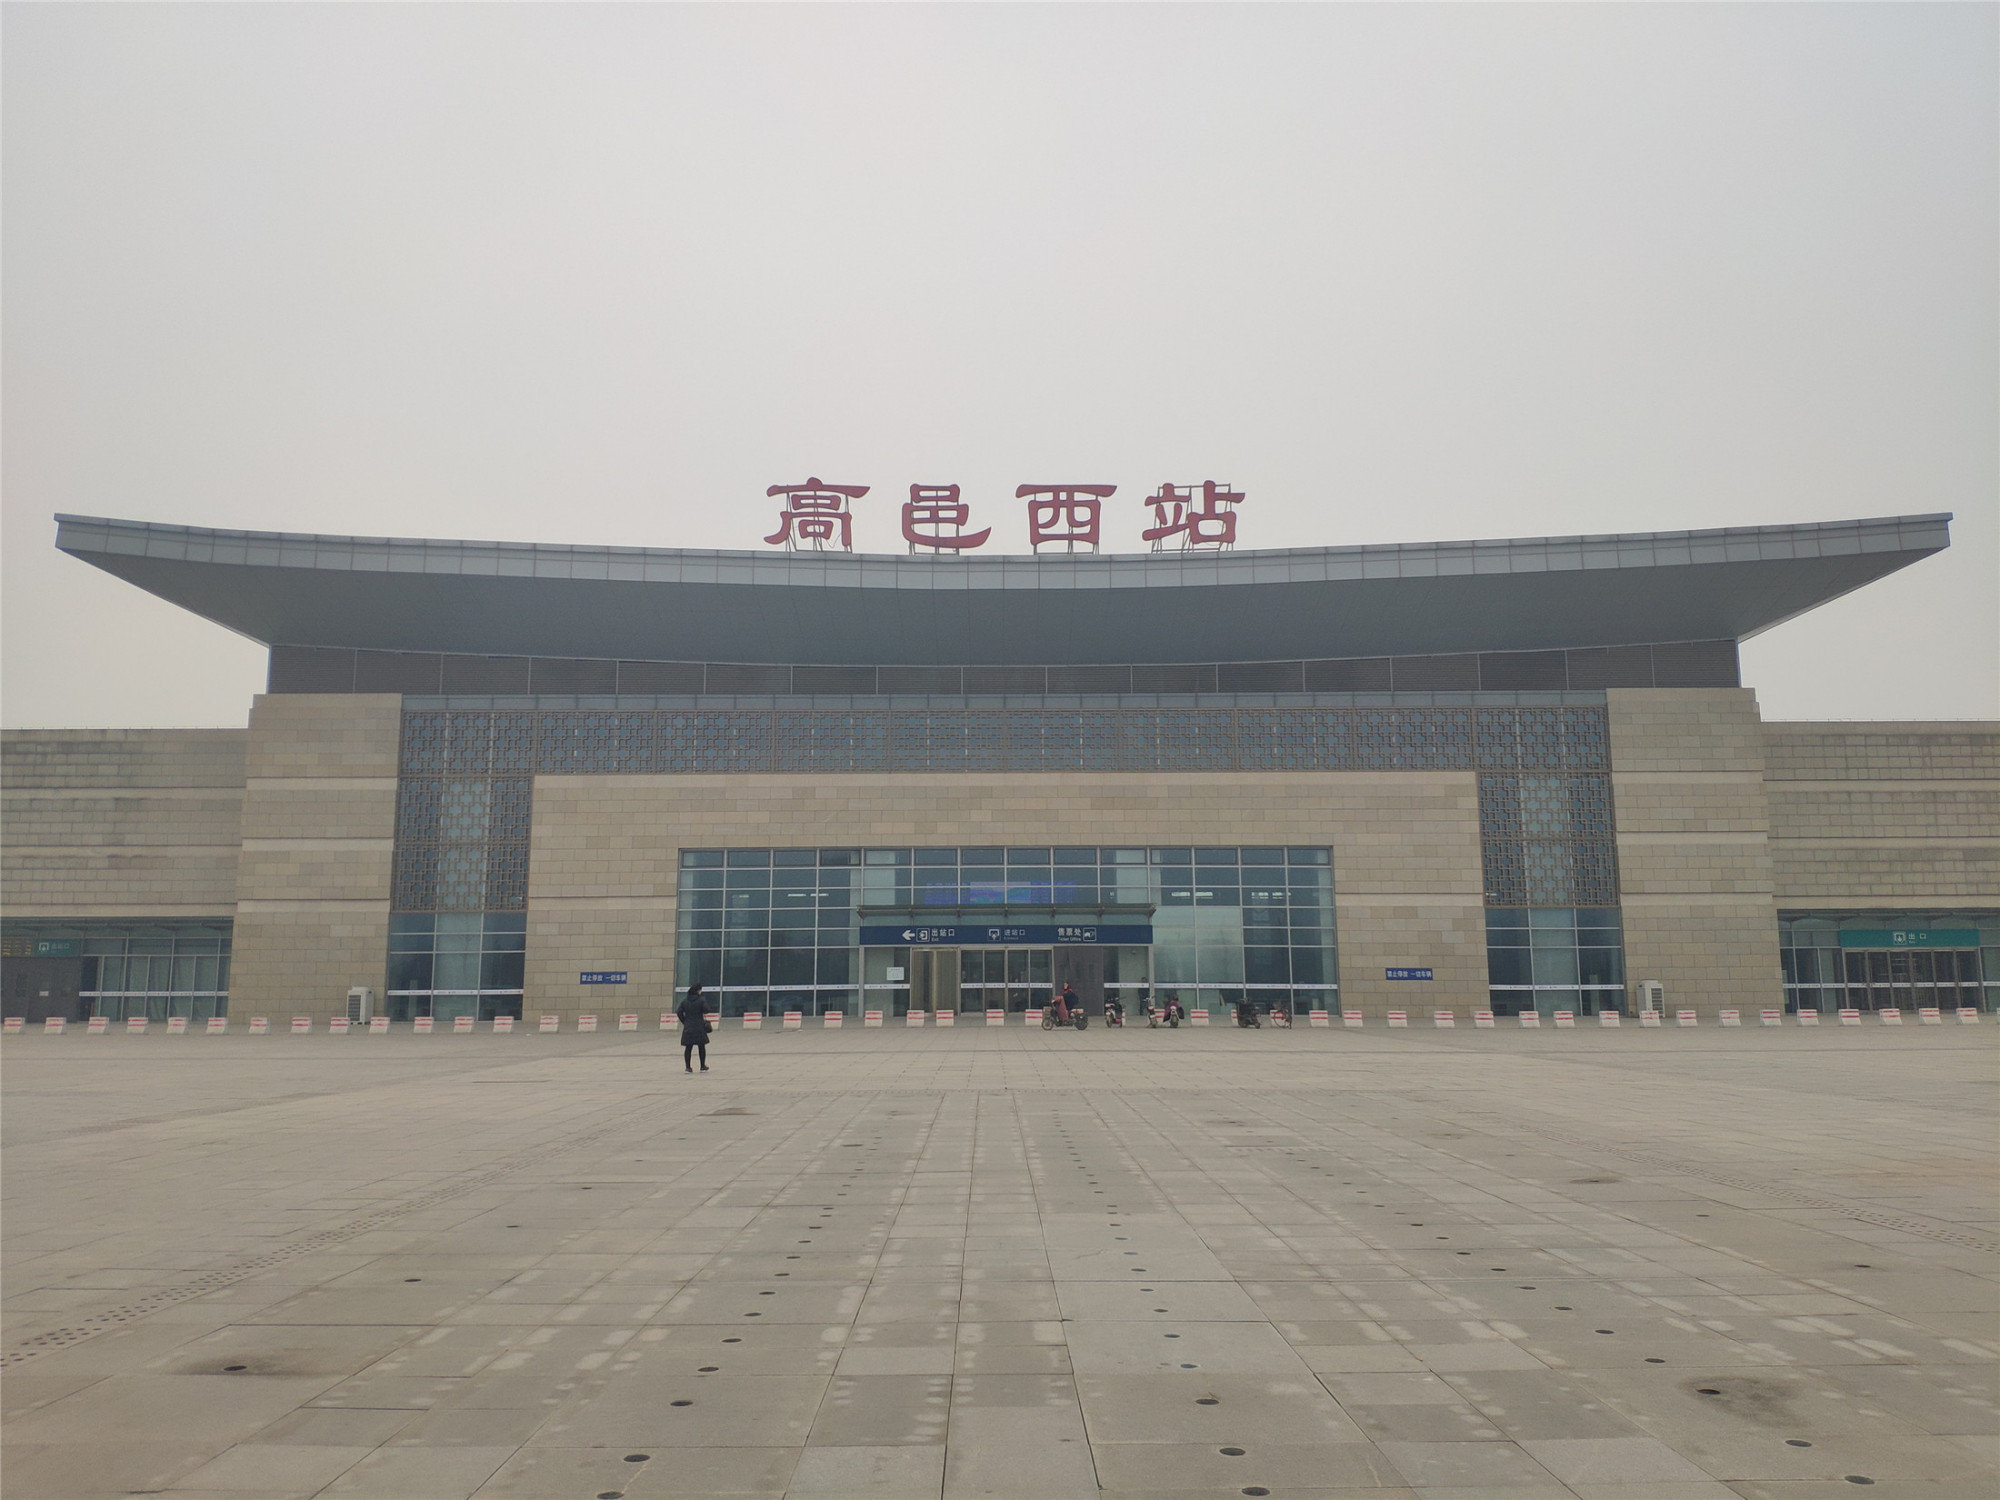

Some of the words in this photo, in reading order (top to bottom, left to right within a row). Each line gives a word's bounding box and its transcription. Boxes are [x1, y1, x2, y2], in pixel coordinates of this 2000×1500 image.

[763, 477, 1246, 549] 高邑西站
[931, 928, 955, 937] 出站口
[1004, 928, 1026, 937] 进站口
[1057, 927, 1082, 937] 售票处
[1908, 932, 1927, 940] 出口
